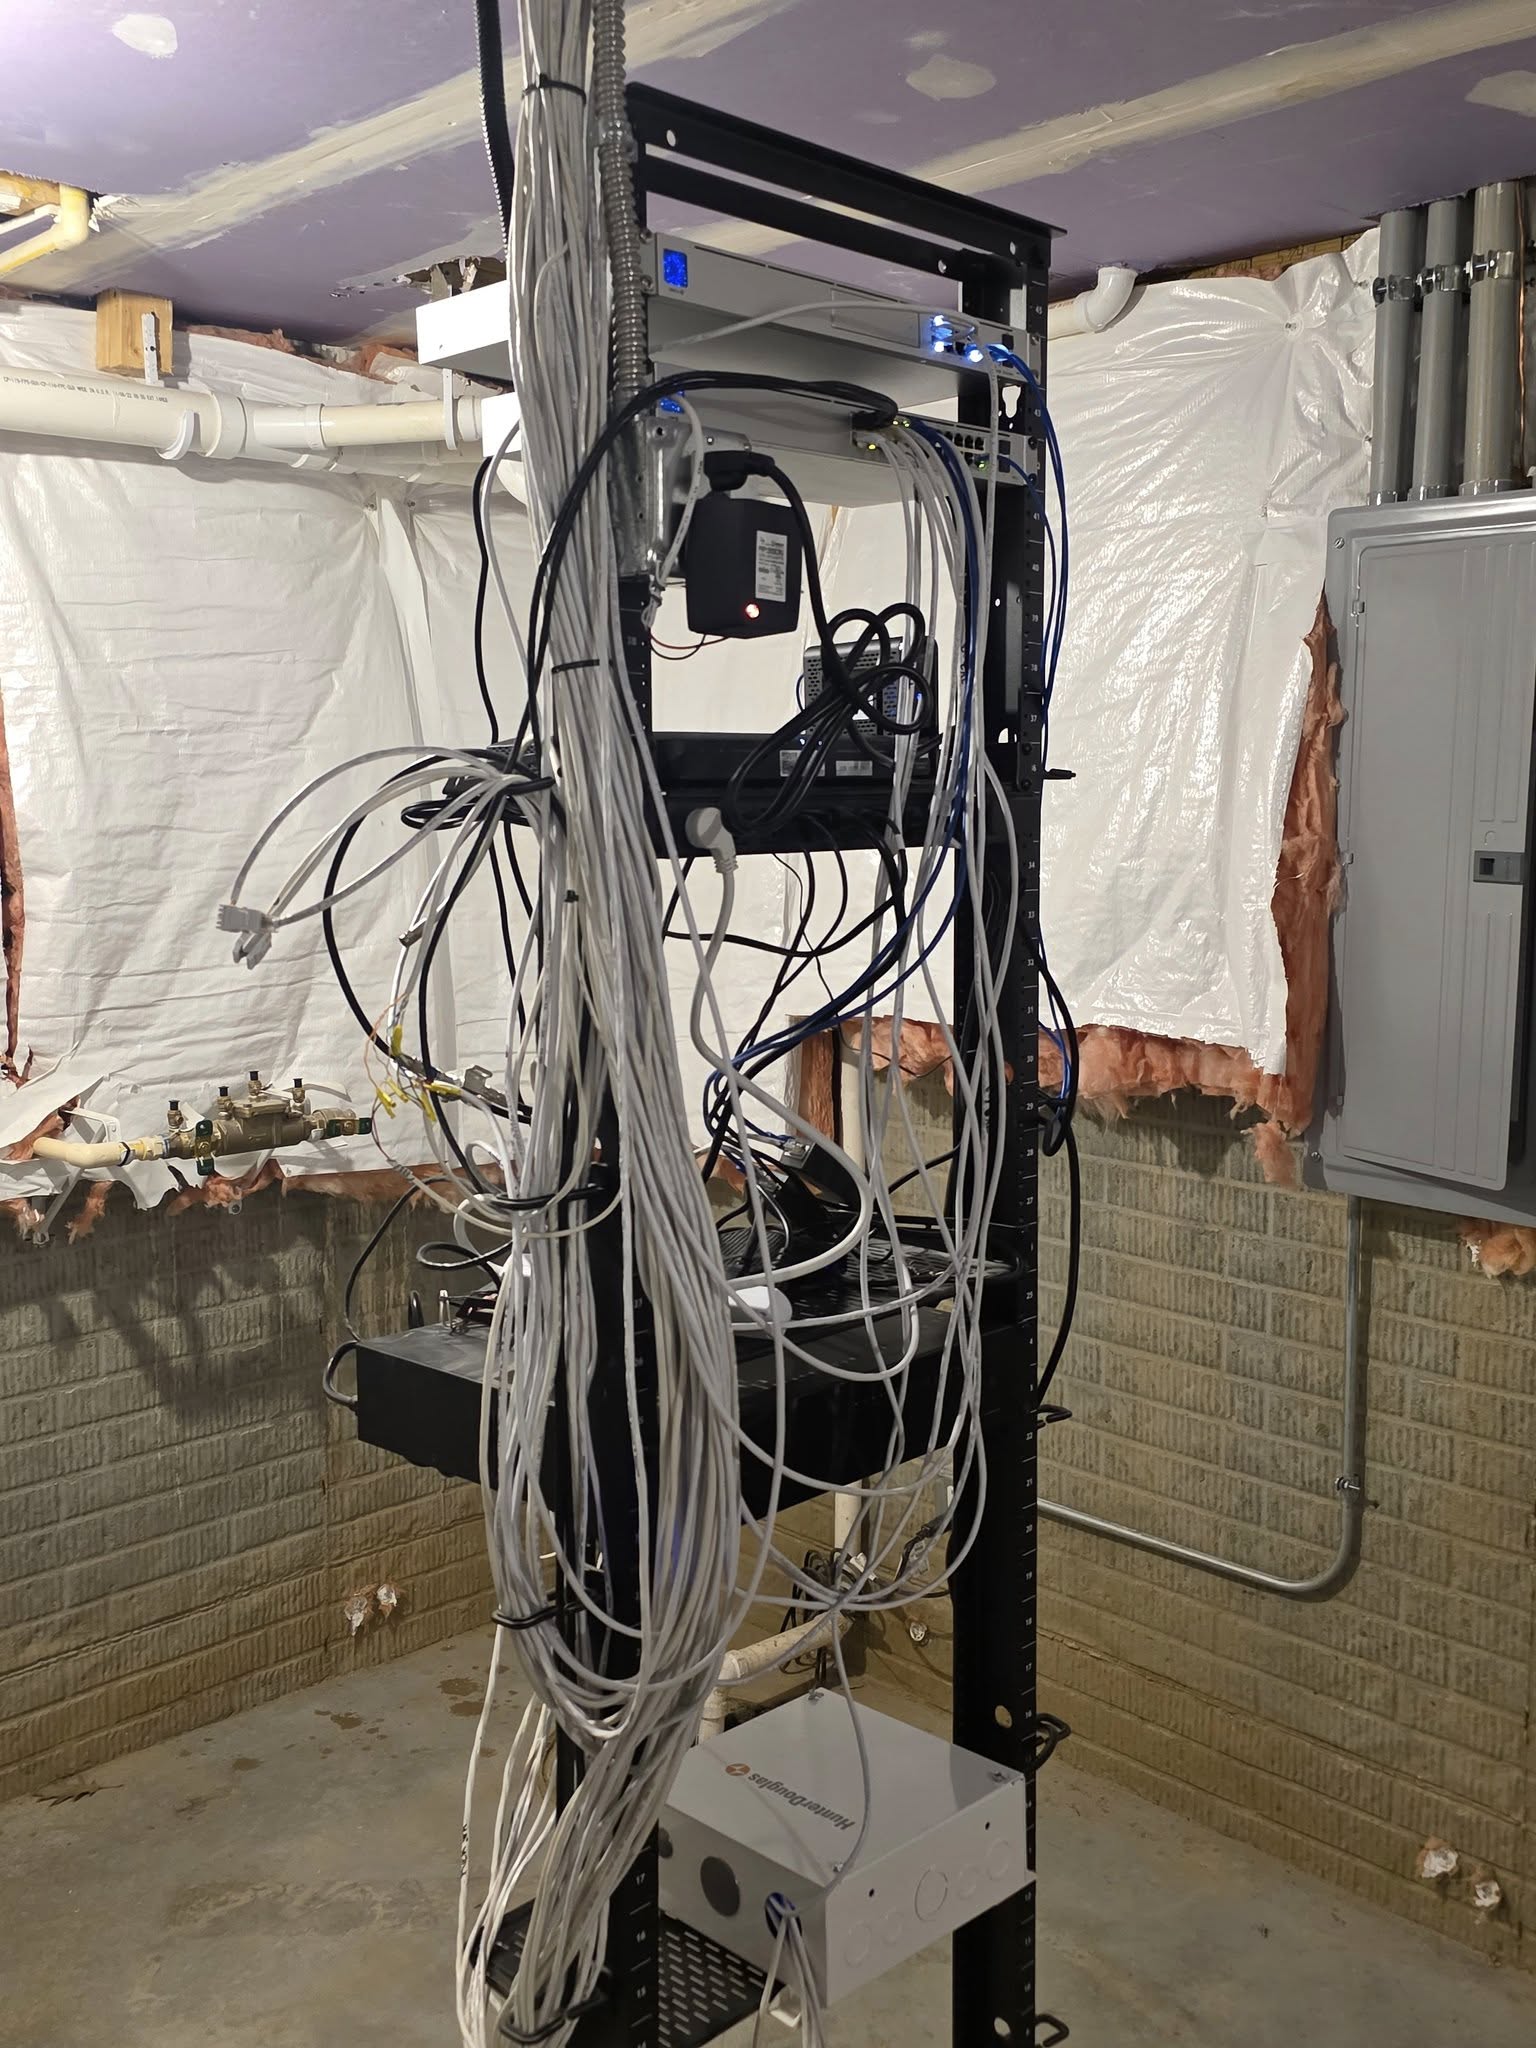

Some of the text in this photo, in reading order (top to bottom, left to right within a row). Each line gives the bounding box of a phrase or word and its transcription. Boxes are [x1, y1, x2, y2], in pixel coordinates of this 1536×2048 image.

[1033, 512, 1040, 521] 41
[1032, 563, 1040, 572] 40
[1031, 614, 1039, 623] 39
[1030, 714, 1037, 723] 37
[1028, 861, 1035, 869] 34
[1027, 1006, 1034, 1014] 31
[1027, 1055, 1034, 1063] 30
[1026, 1103, 1034, 1111] 29
[1026, 1196, 1034, 1205] 27
[748, 1772, 856, 1831] HunterDouglas
